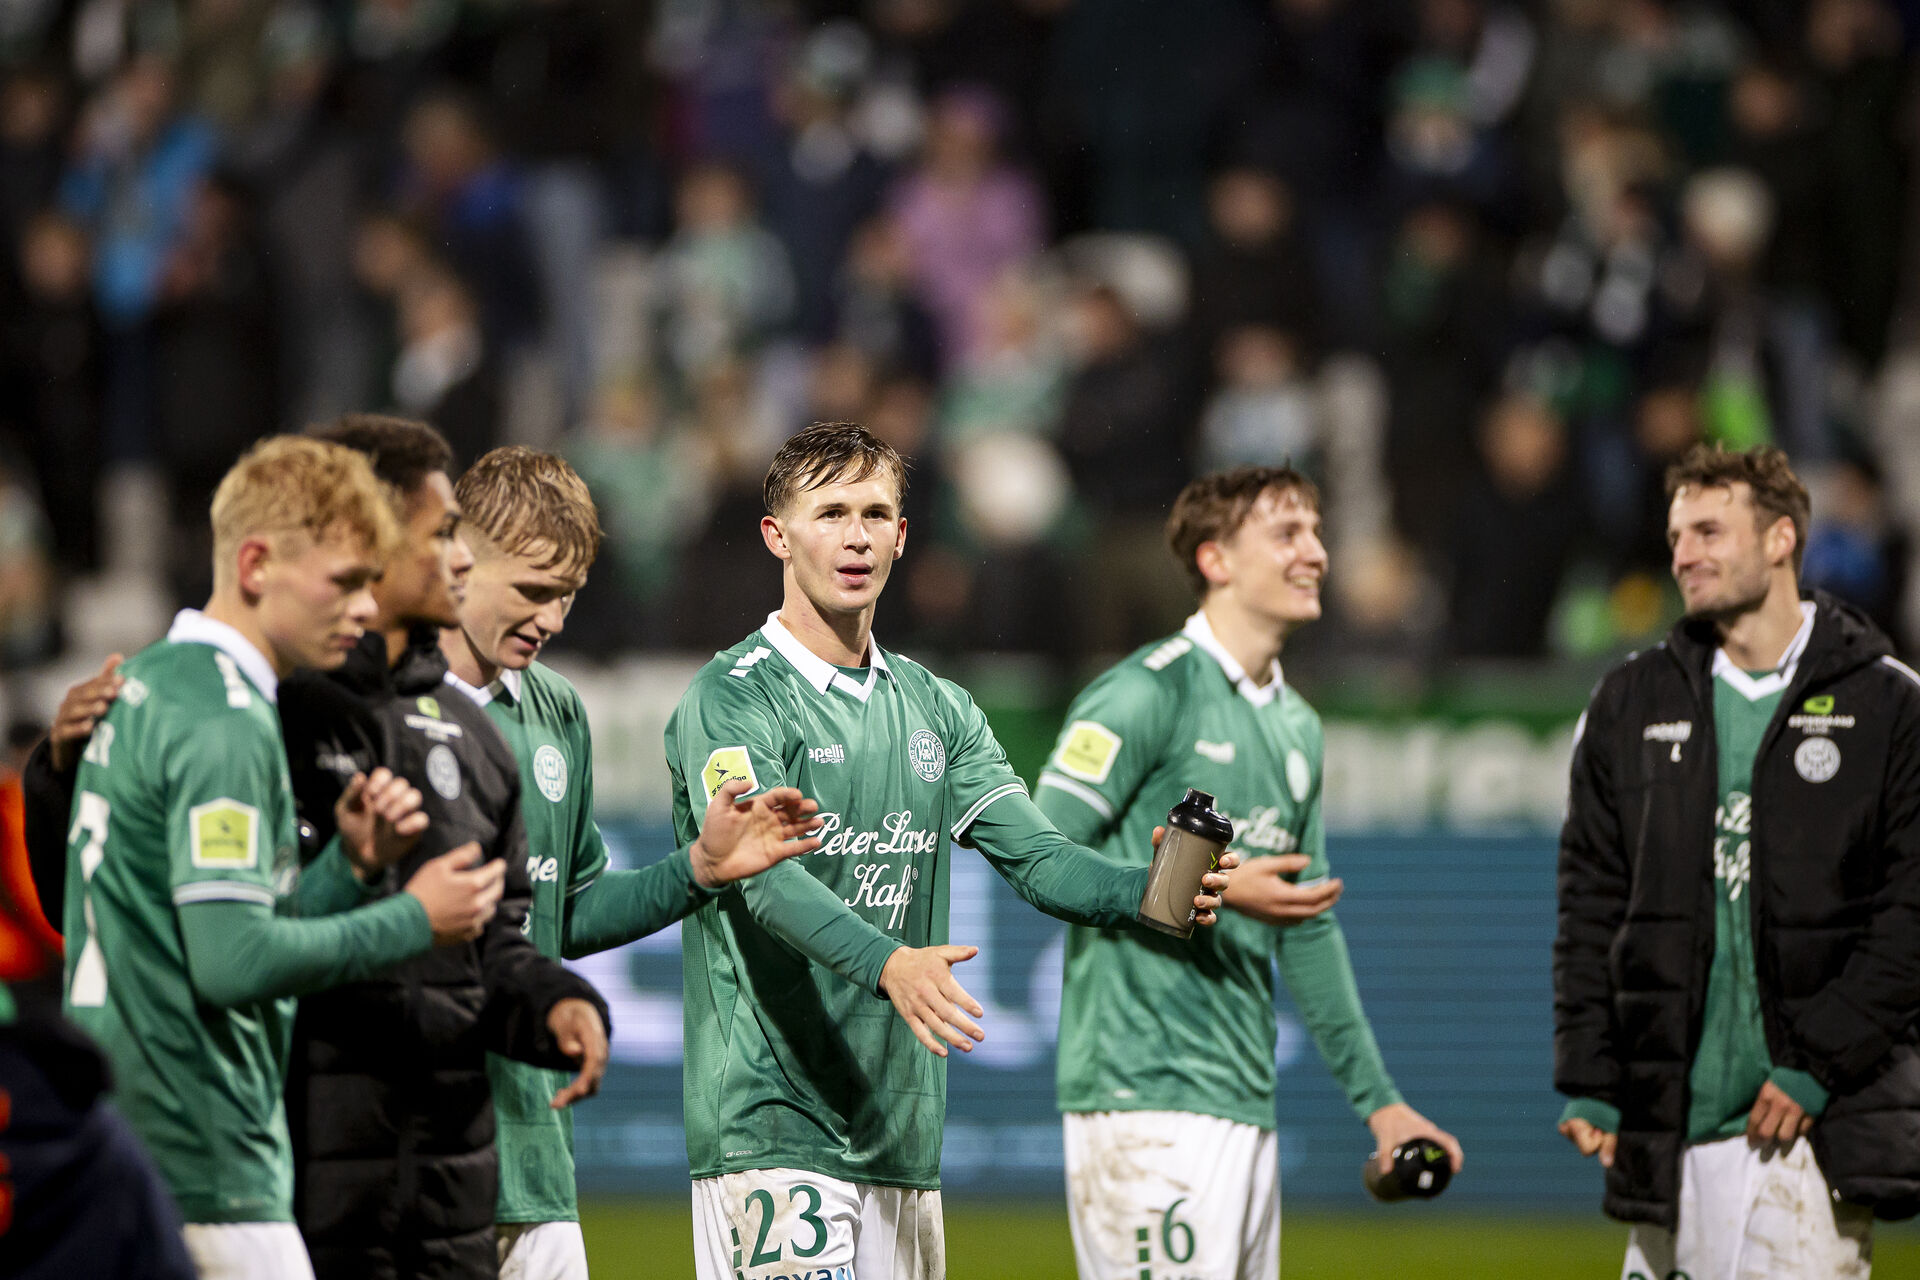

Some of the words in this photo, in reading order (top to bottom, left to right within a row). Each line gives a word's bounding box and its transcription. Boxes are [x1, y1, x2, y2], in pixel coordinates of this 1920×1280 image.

[820, 757, 846, 765] SPORT
[803, 811, 880, 856] Peter
[744, 1184, 828, 1268] 23
[1162, 1198, 1195, 1264] 6
